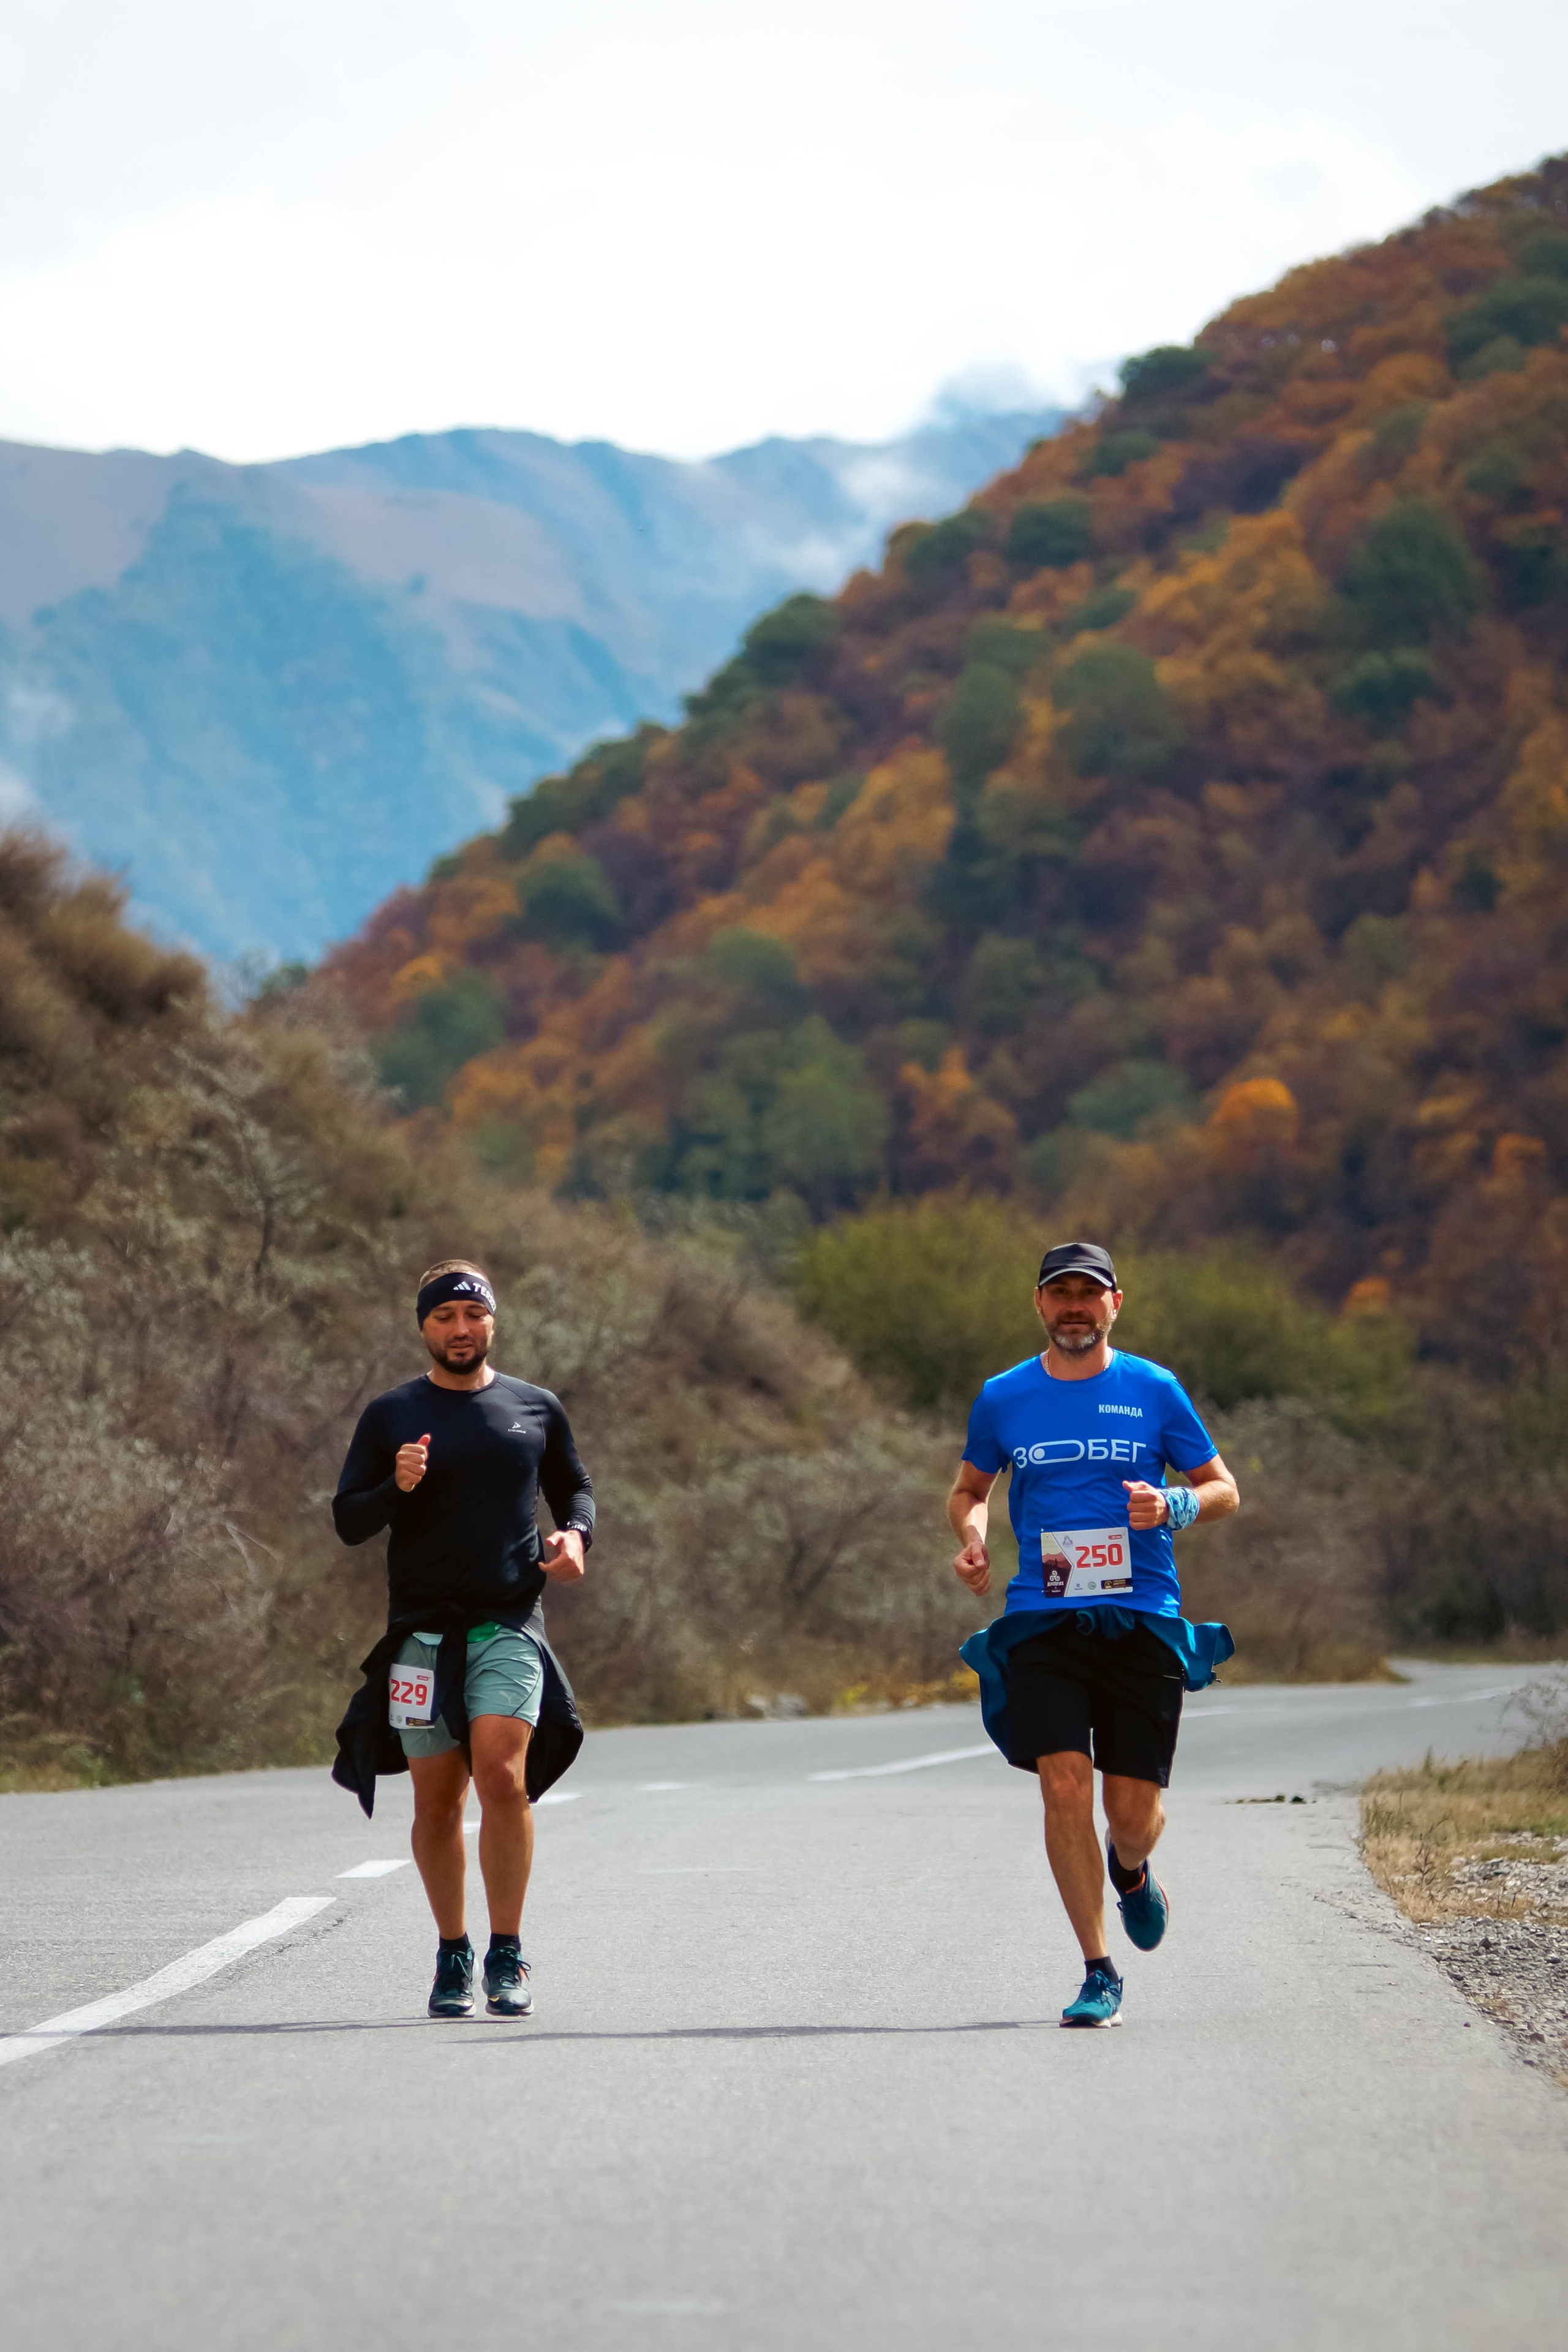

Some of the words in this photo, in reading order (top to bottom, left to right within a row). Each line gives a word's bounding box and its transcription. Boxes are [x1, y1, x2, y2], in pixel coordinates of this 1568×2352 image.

[1098, 1404, 1143, 1419] КОМАНДА
[1075, 1543, 1123, 1569] 250
[390, 1678, 428, 1706] 229
